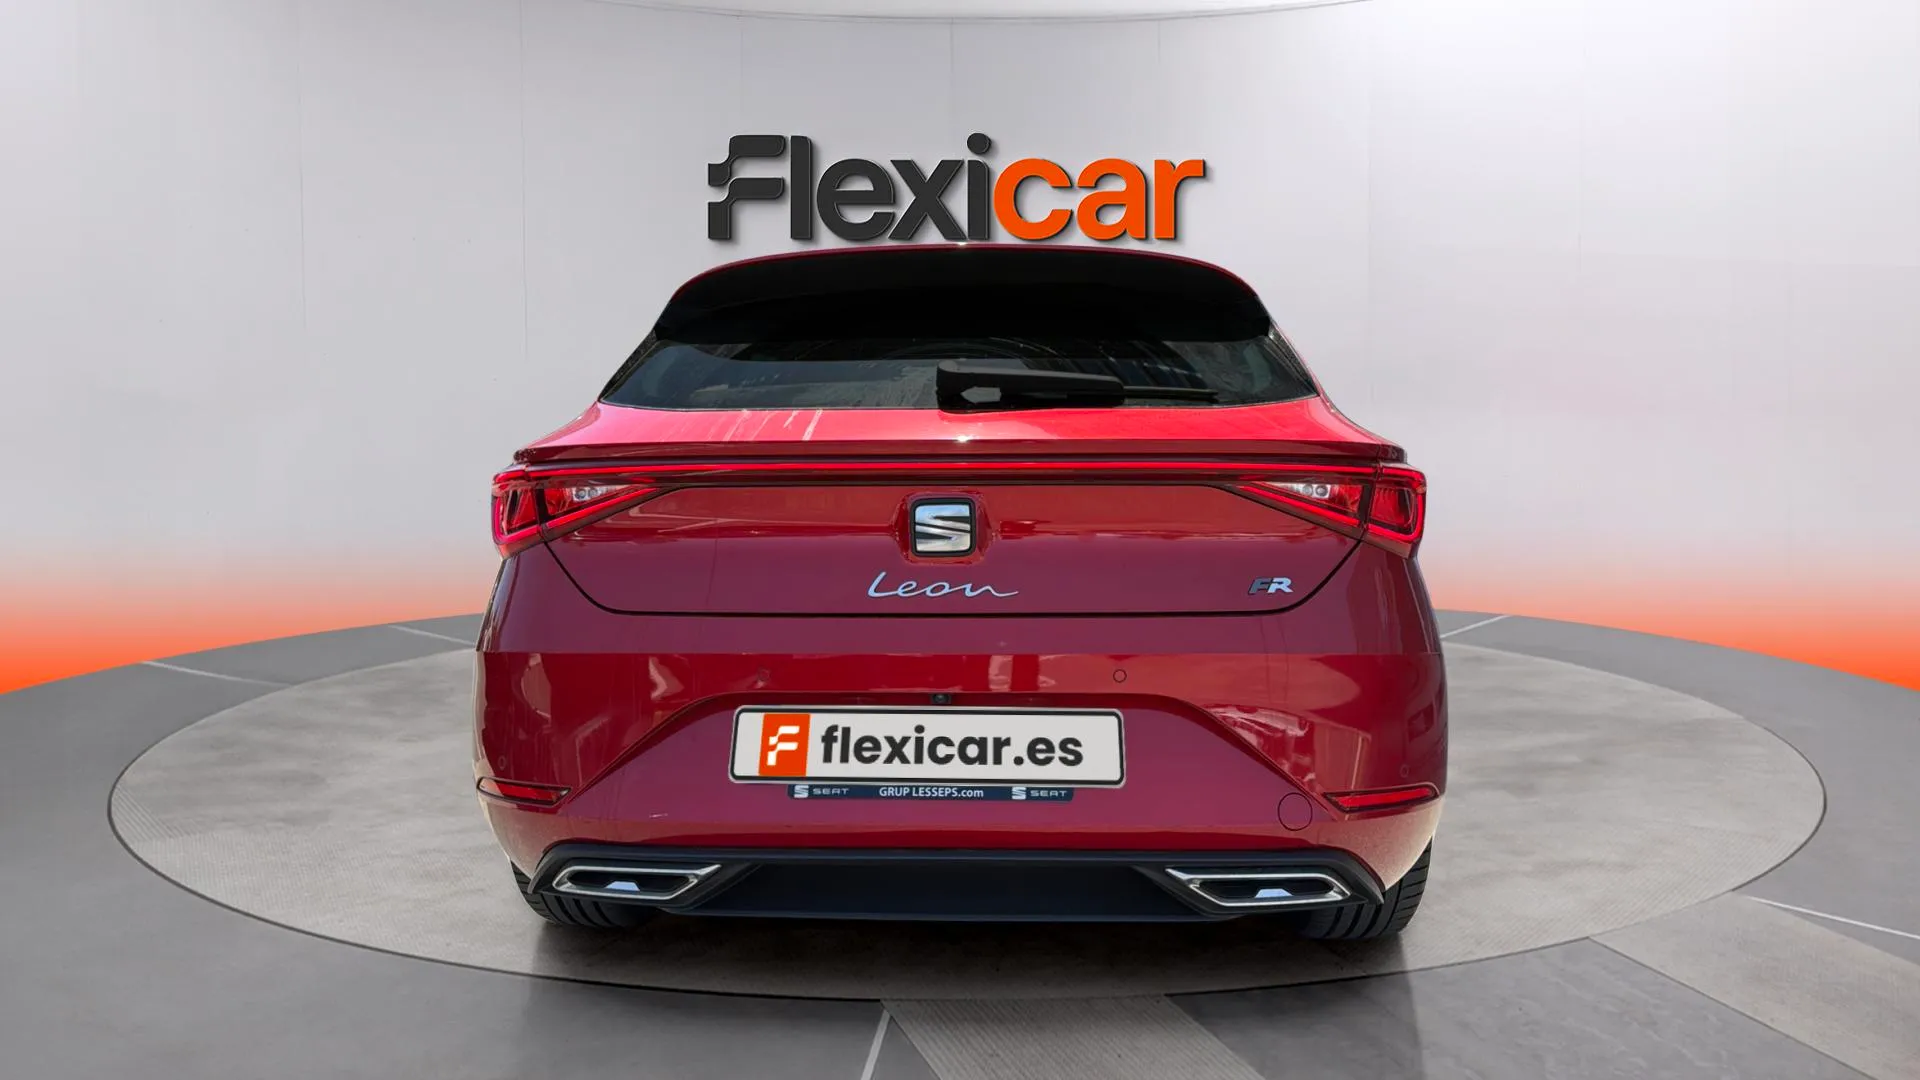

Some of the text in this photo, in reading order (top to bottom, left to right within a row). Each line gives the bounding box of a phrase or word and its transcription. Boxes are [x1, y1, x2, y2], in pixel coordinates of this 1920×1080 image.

[708, 132, 1206, 241] Flexicar
[867, 571, 1020, 598] Leon
[1248, 577, 1294, 595] FR
[820, 724, 1085, 767] flexicar.es
[812, 787, 850, 796] SEAT
[879, 786, 910, 797] GRUP
[911, 786, 985, 798] LESSEPS.com
[1029, 789, 1068, 798] SEAT
